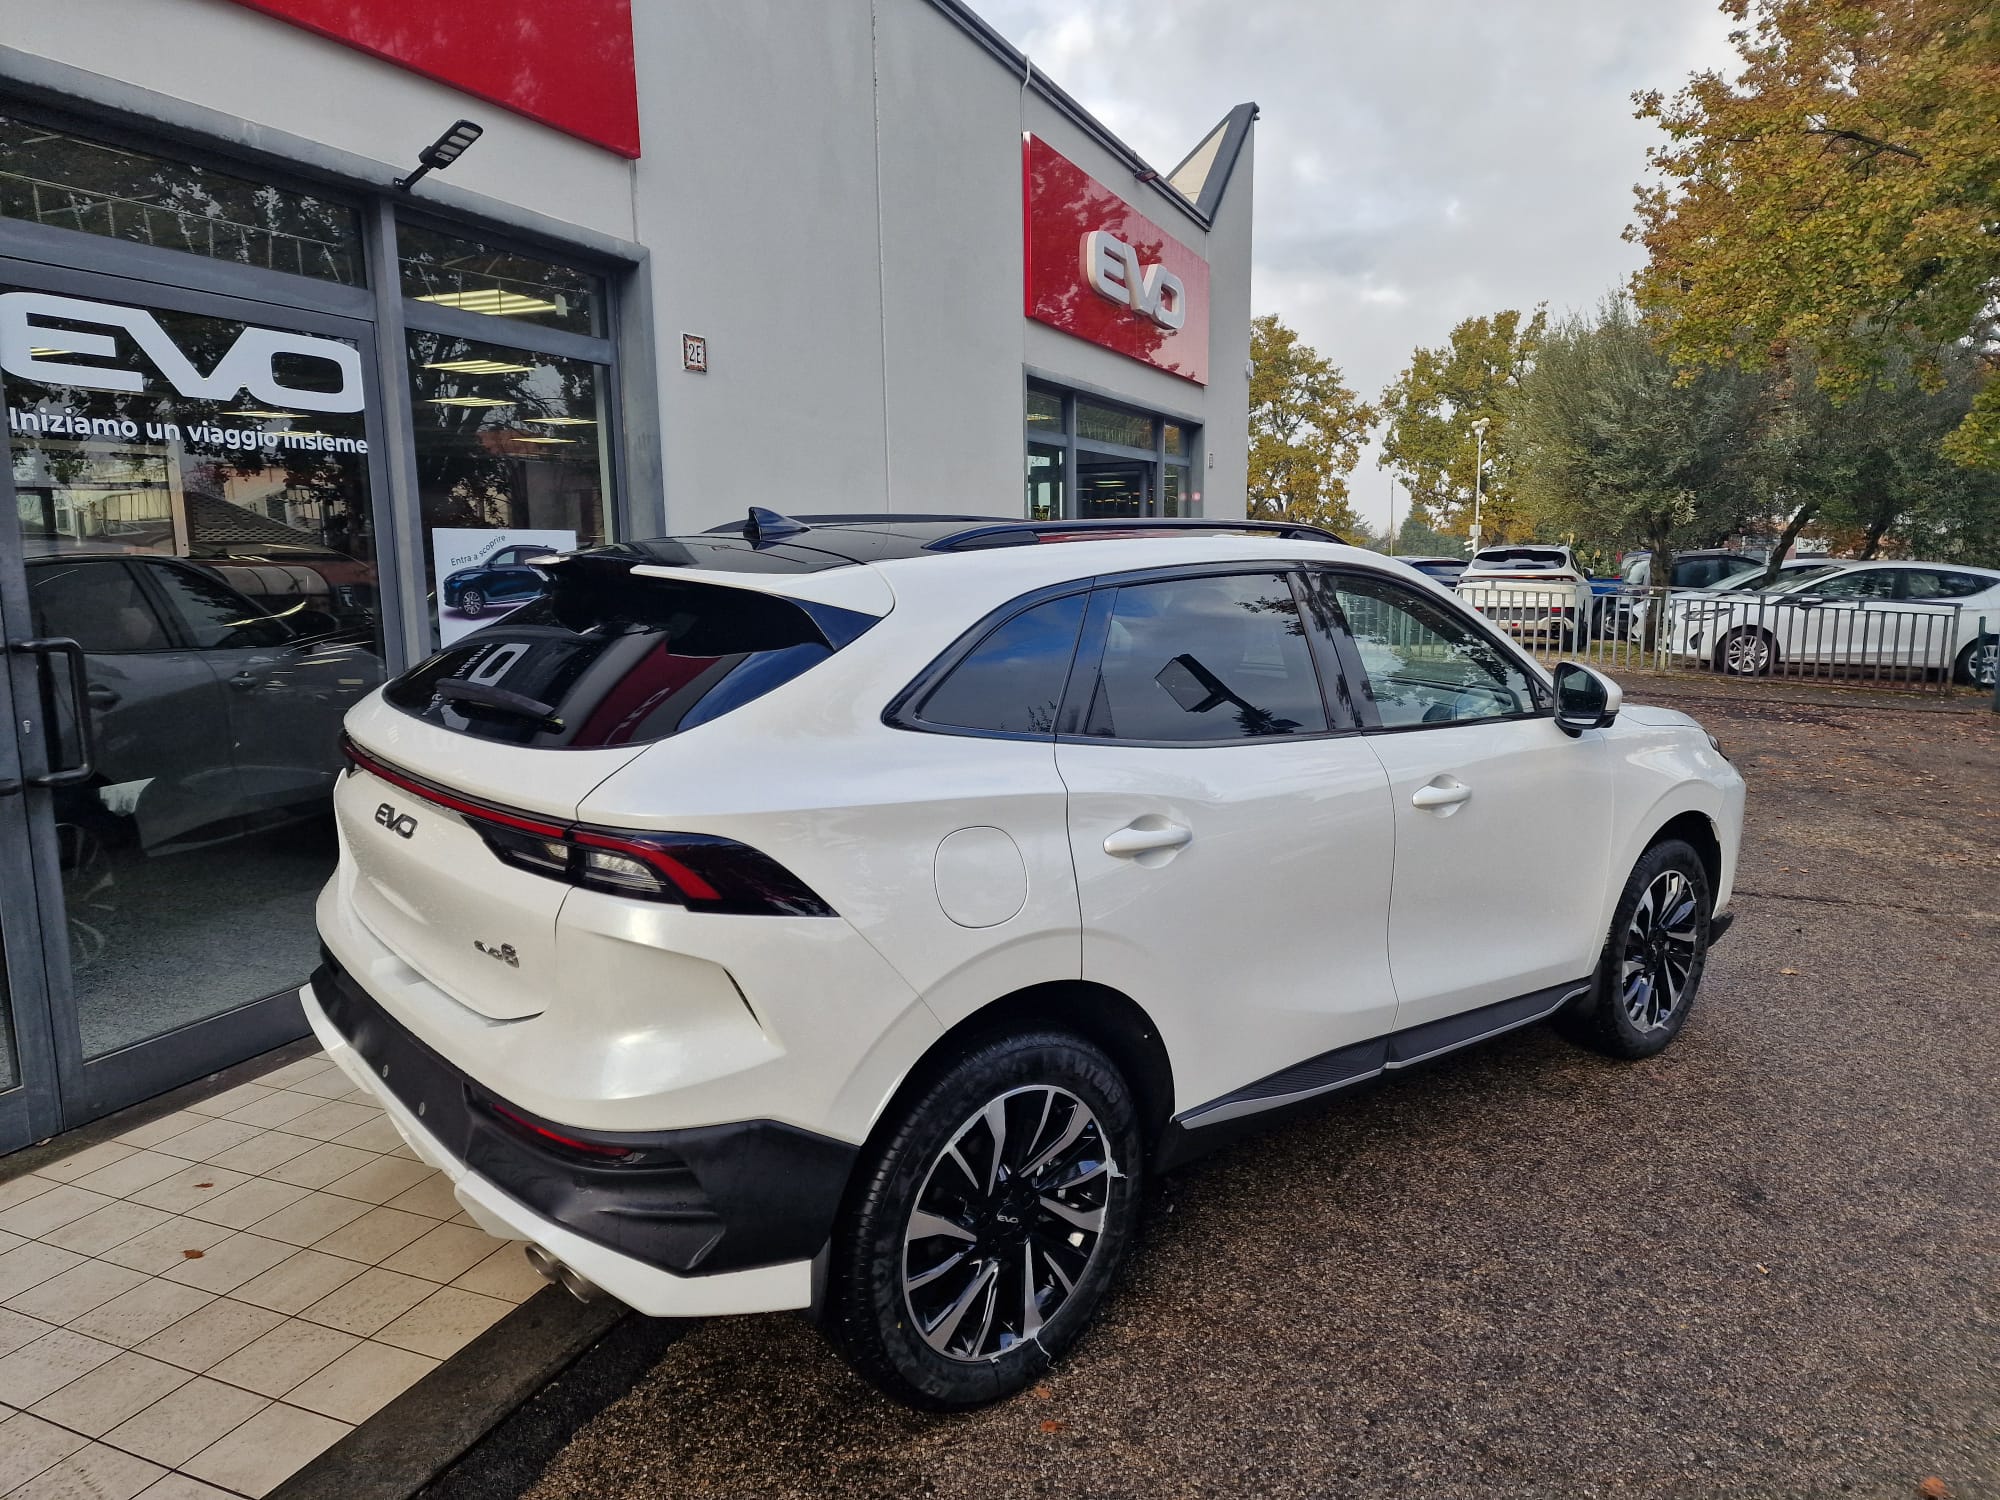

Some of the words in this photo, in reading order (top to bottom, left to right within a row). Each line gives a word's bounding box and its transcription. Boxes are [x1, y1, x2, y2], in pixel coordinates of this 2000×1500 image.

[1085, 230, 1186, 330] EVO
[0, 291, 366, 414] EVO
[688, 343, 702, 364] 2E
[9, 406, 139, 439] Iniziamo
[146, 422, 181, 442] un
[190, 420, 278, 451] viaggio
[284, 427, 369, 455] insieme
[450, 554, 473, 567] Entra
[479, 534, 506, 556] scoprire
[374, 802, 418, 840] EVO
[996, 1215, 1019, 1224] EVO
